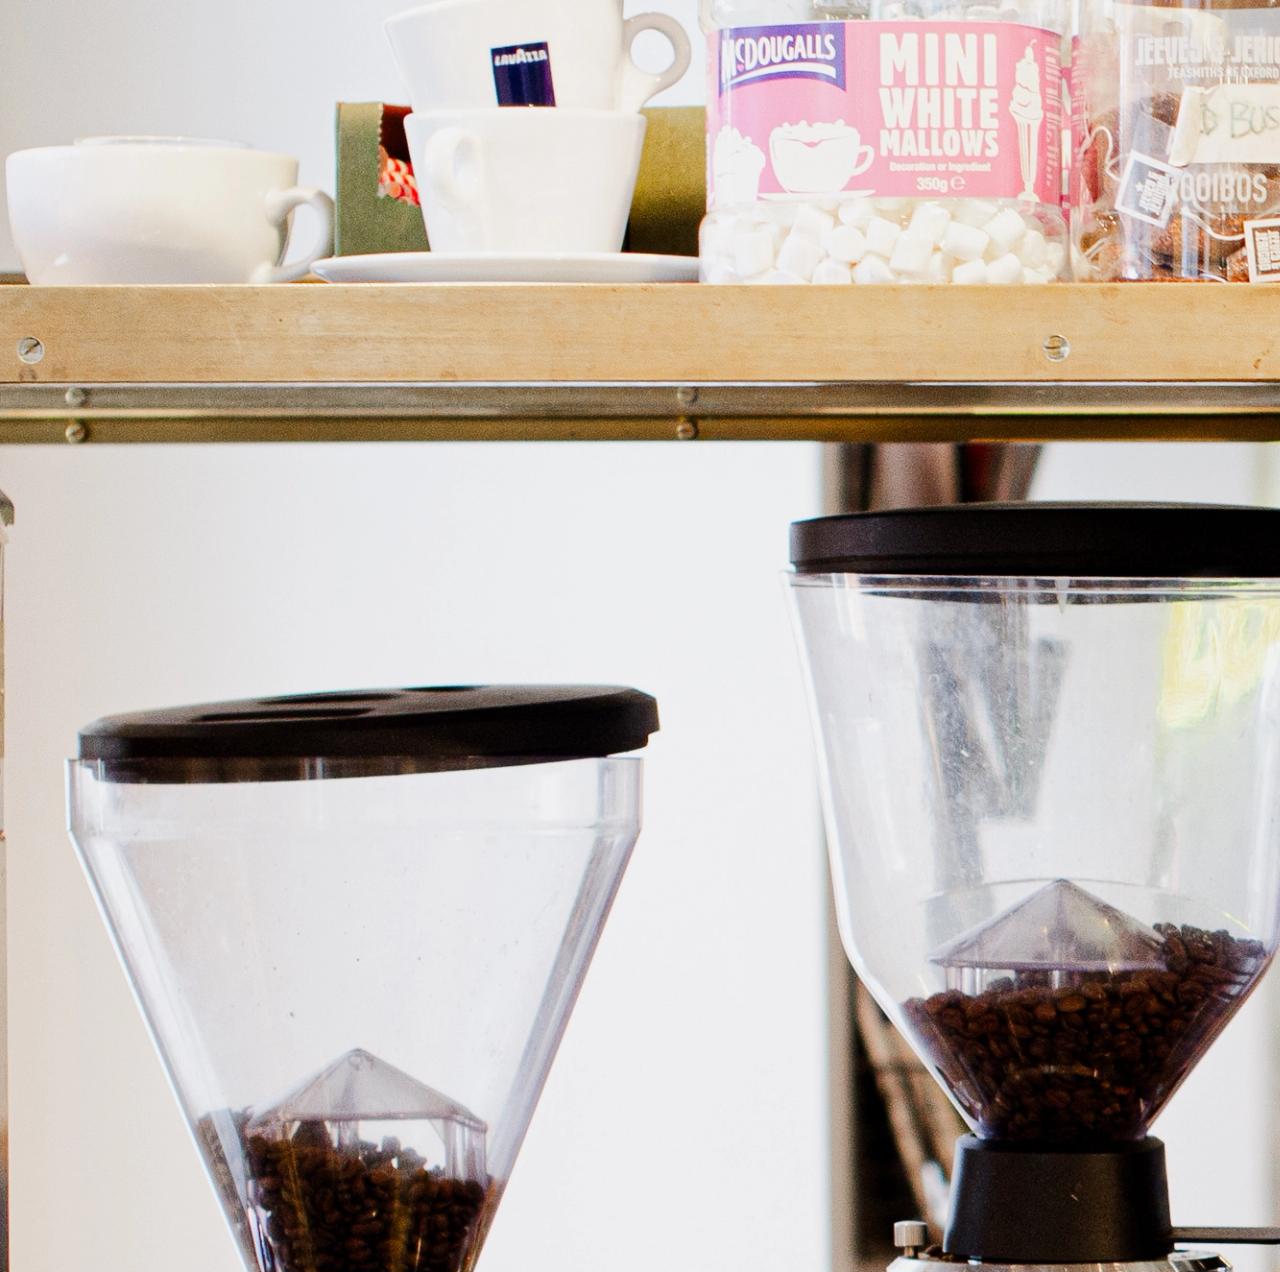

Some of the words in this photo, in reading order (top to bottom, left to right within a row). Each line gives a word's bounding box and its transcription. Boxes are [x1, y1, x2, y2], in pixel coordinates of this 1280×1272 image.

[494, 48, 547, 66] LAVAZZA
[879, 33, 997, 87] MINI
[879, 87, 999, 129] WHITE
[879, 129, 999, 157] MALLOWS
[890, 162, 936, 172] Decoration
[949, 162, 991, 175] Ingredient
[916, 177, 948, 193] 350g
